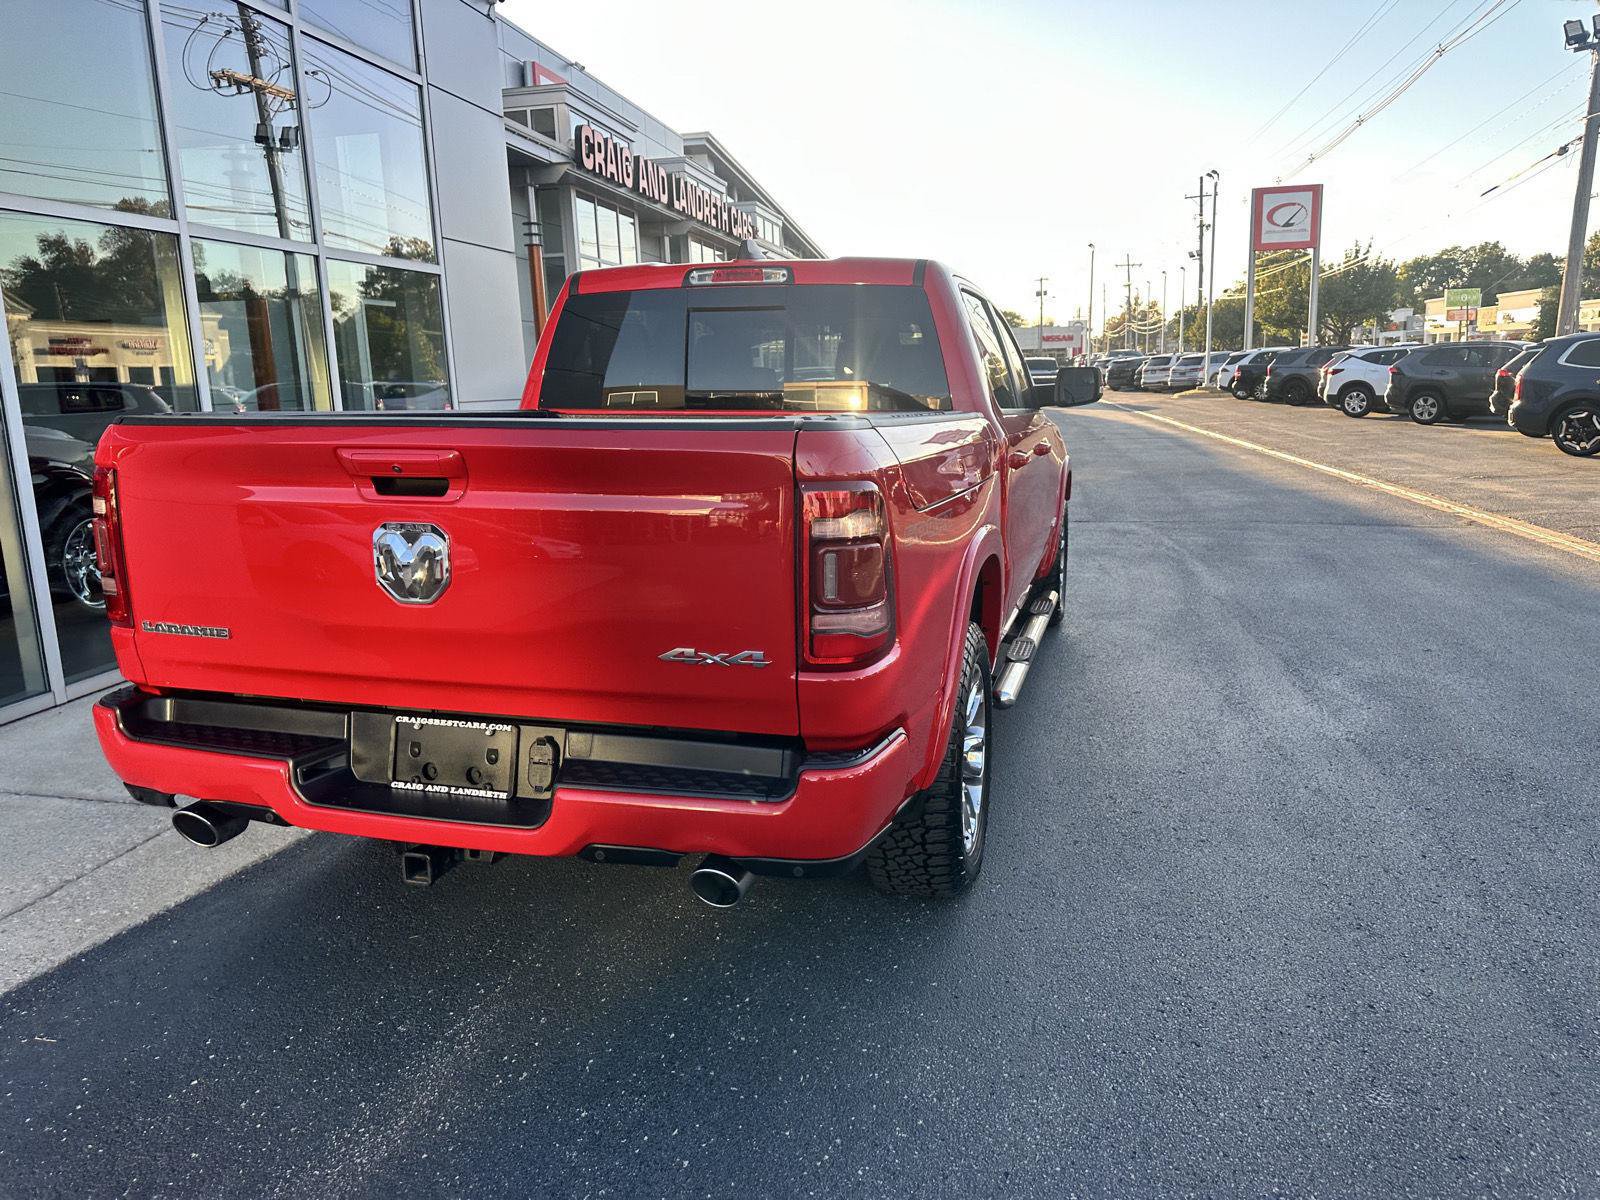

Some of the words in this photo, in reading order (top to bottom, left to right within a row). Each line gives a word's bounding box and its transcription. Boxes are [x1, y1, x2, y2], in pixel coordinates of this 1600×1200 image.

[579, 125, 634, 189] CRAIG
[639, 159, 669, 204] AND
[672, 173, 729, 232] LANDRETH
[730, 206, 754, 240] CARS
[1041, 334, 1074, 342] NISSAN
[142, 620, 229, 639] LARAMIE
[395, 716, 512, 731] CRAIGSBESTCARS.COM
[391, 781, 423, 791] CRAIG
[425, 783, 449, 794] AND
[450, 787, 508, 799] LANDRETH
